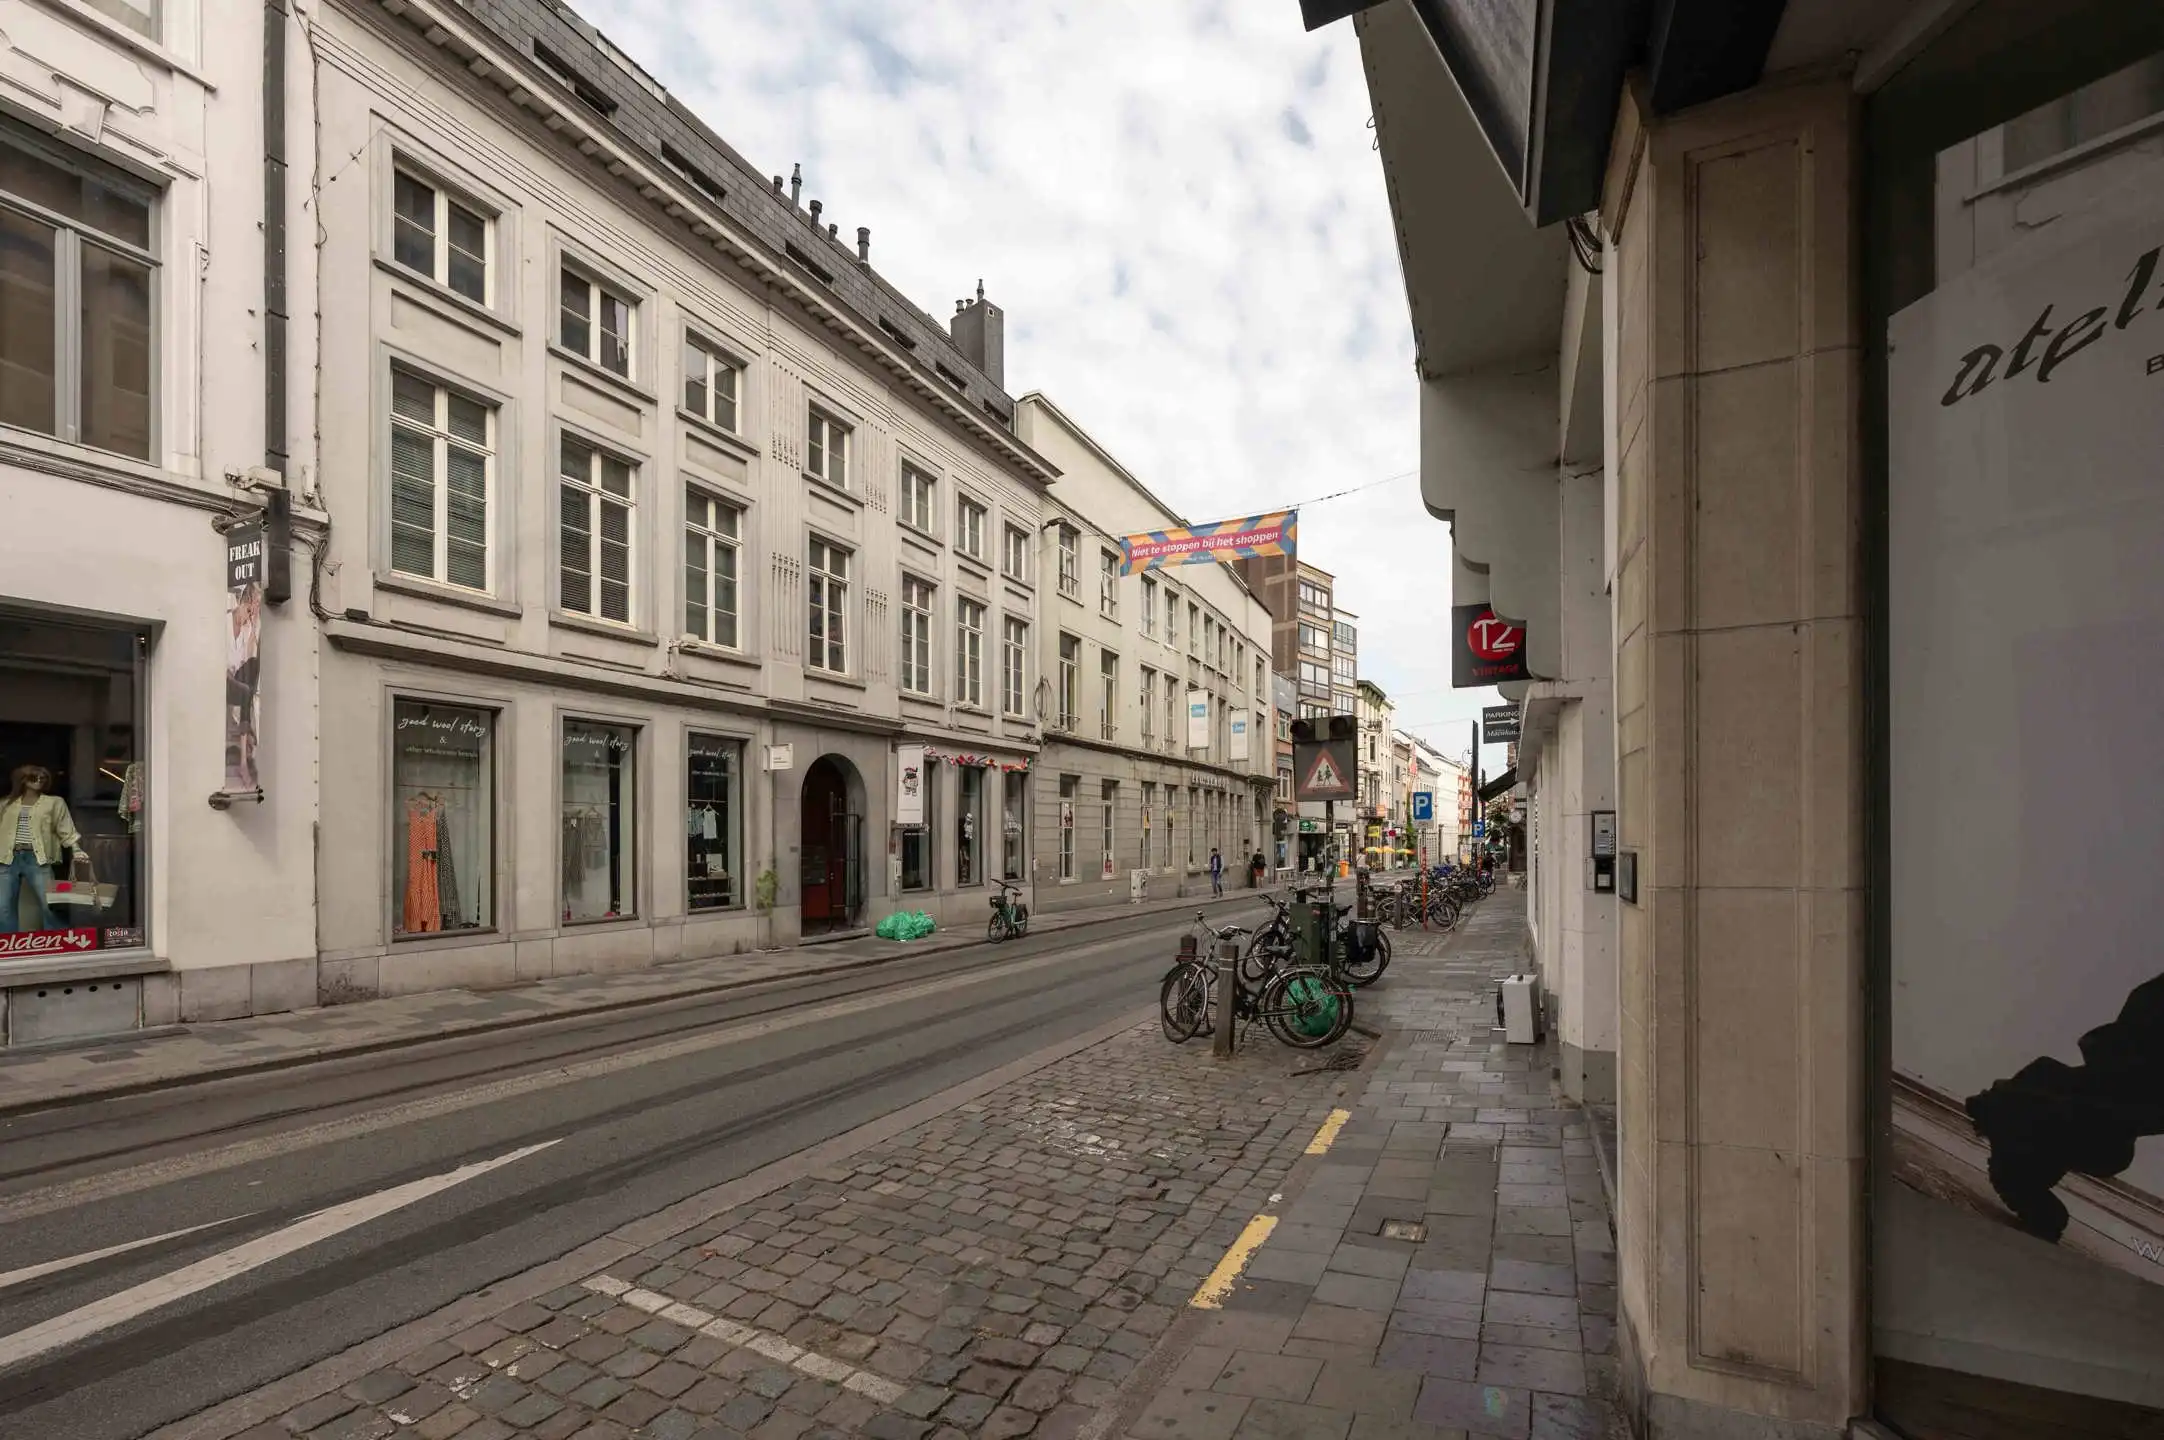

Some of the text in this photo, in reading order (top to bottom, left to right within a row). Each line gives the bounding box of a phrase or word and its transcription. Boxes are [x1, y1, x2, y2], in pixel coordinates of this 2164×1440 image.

[229, 541, 261, 562] FREAK
[1131, 531, 1279, 557] Niet te stoppen bij het shoppen
[235, 562, 255, 581] OUT
[1472, 664, 1520, 677] VINTAGE
[398, 714, 487, 737] good wool story
[1415, 795, 1429, 816] P
[1473, 823, 1483, 835] P
